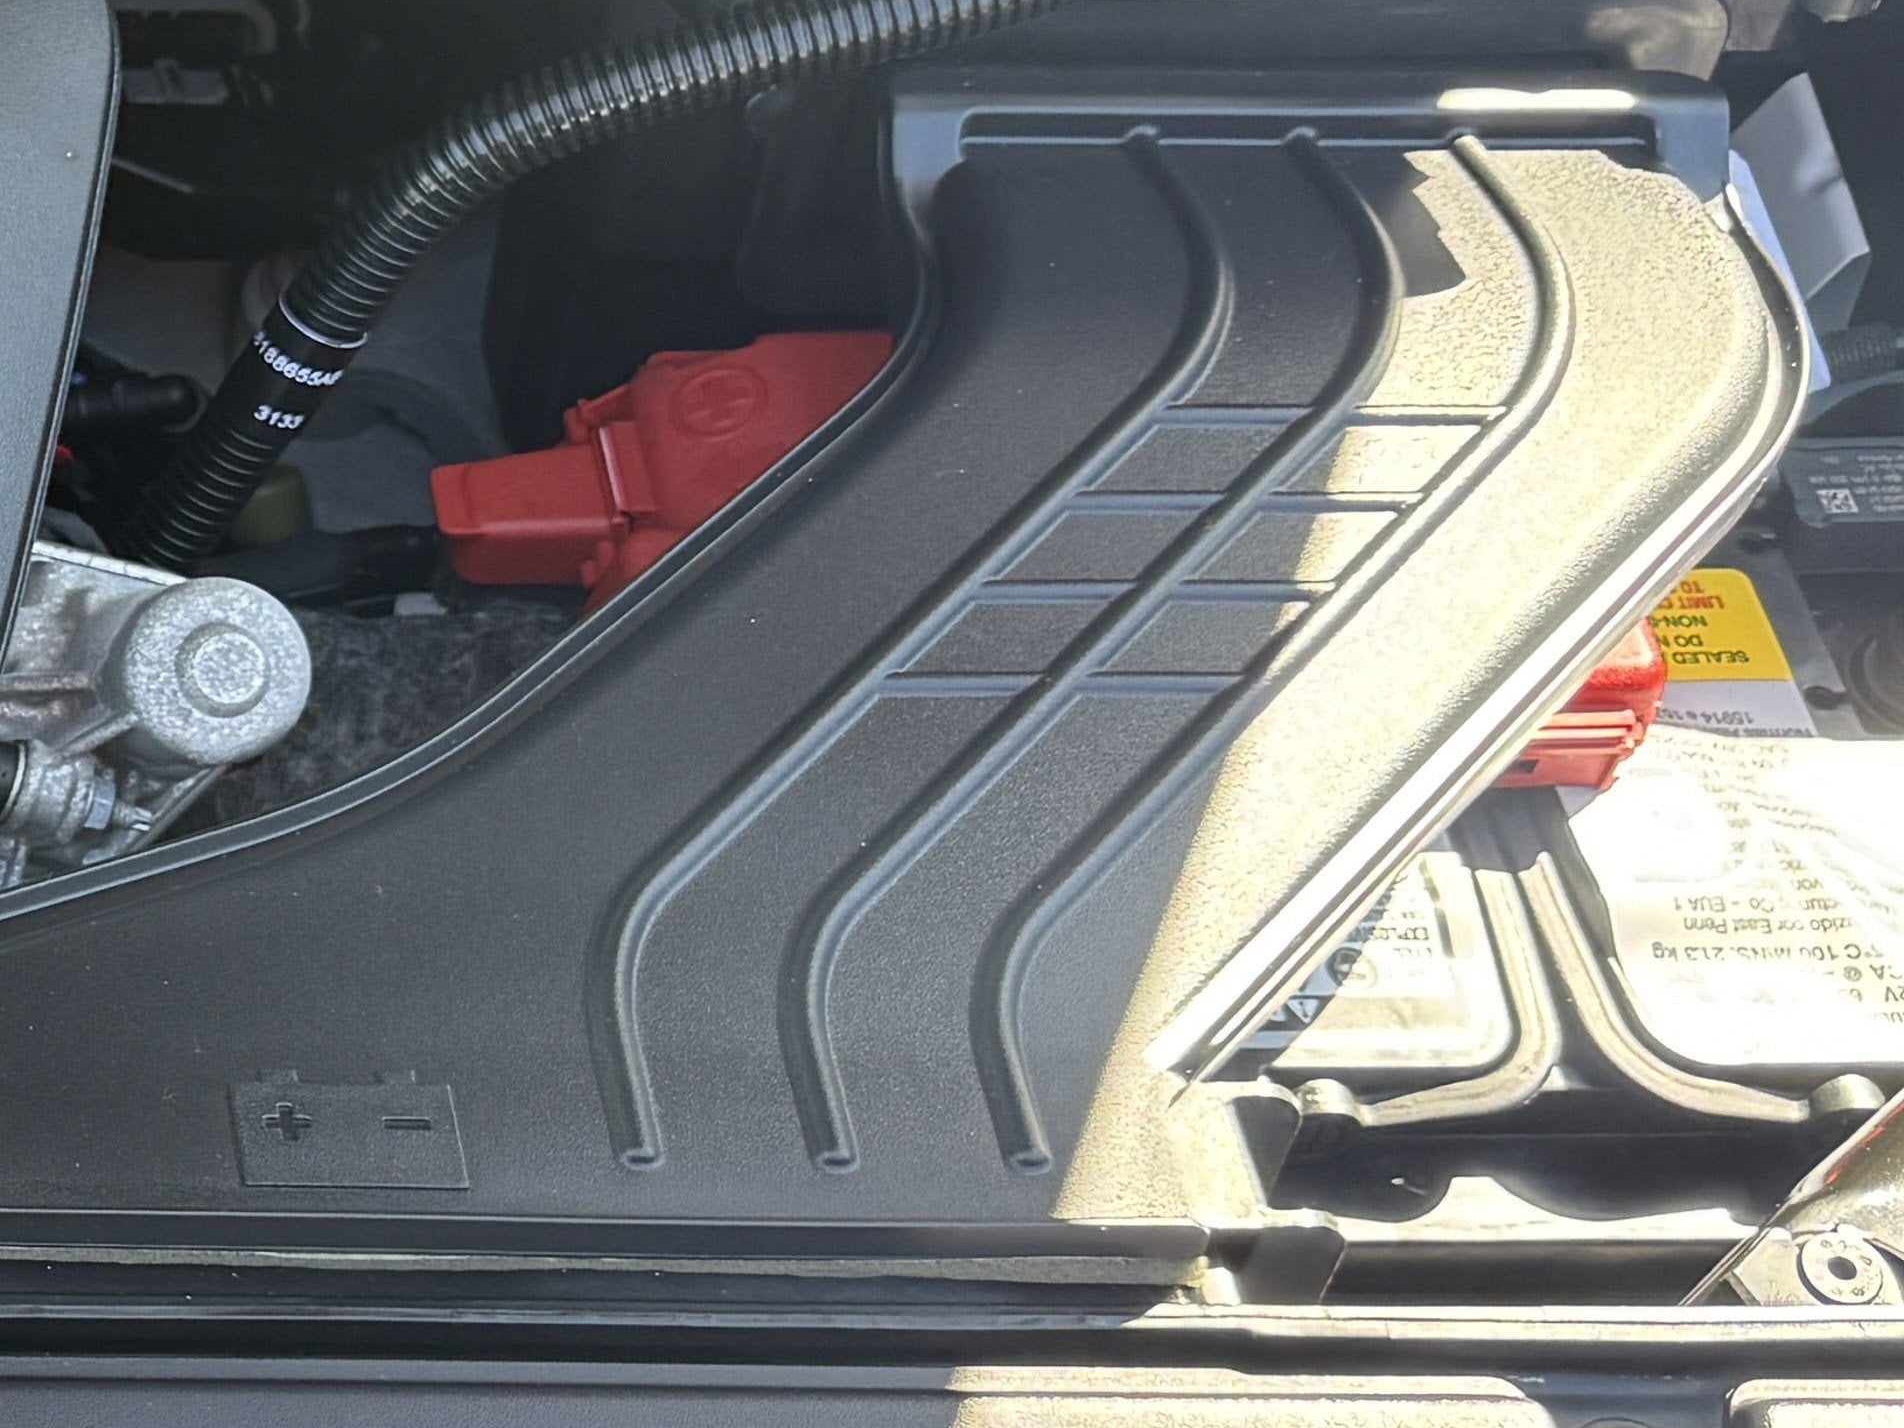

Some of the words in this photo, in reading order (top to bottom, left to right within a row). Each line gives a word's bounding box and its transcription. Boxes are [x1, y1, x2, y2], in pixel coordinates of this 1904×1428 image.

[1678, 595, 1725, 610] LIMIT
[1674, 634, 1704, 648] DO
[1671, 650, 1750, 665] SEALED
[1683, 917, 1728, 934] Penn
